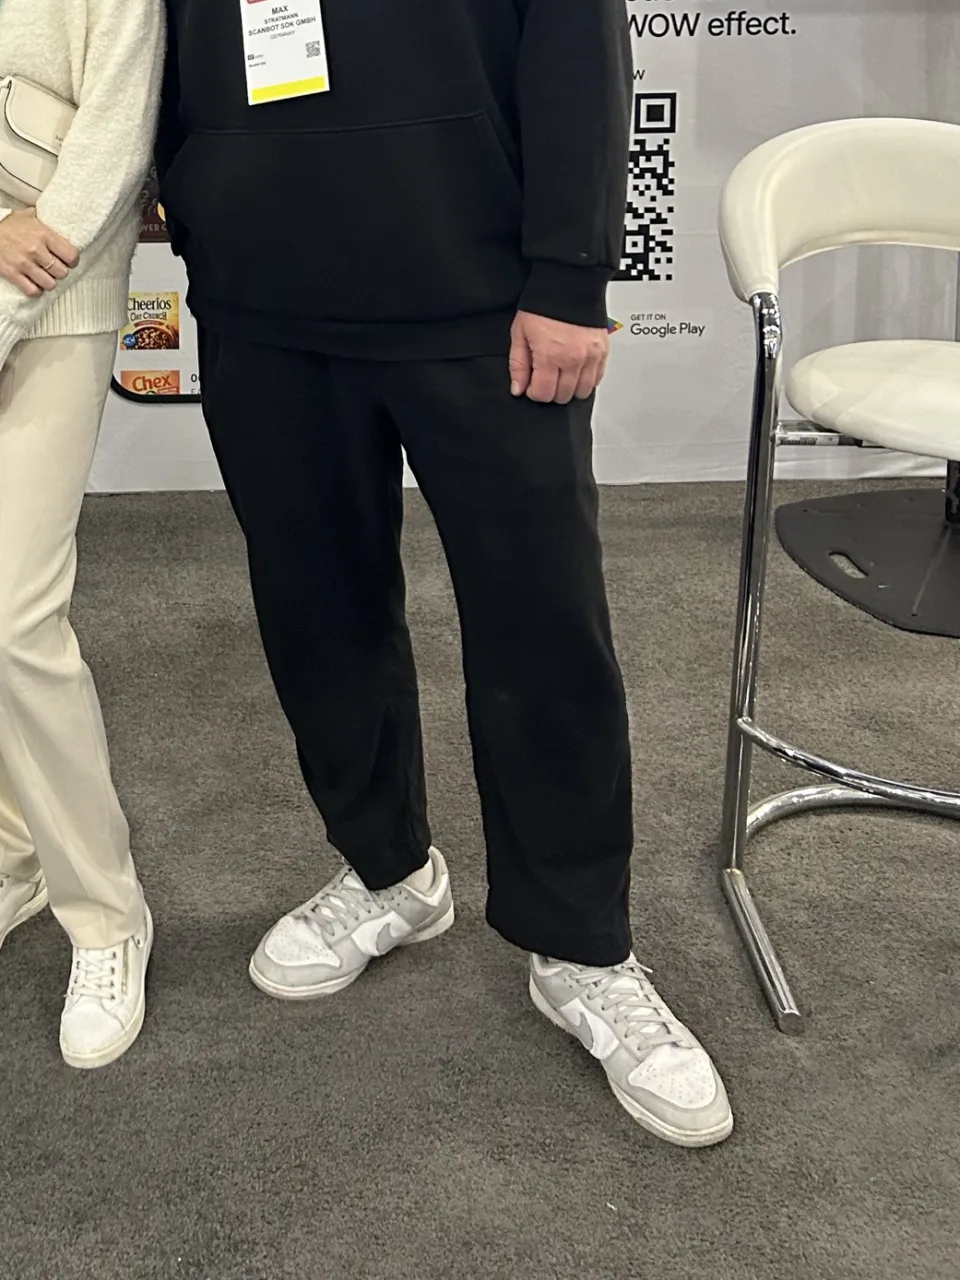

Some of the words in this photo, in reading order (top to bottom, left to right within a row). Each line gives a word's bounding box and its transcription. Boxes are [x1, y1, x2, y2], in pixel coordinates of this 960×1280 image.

[271, 5, 288, 15] MAX
[248, 24, 279, 37] SCANBOT
[628, 12, 701, 38] WOW
[707, 10, 797, 37] effect.
[127, 296, 172, 311] Cheerios
[630, 313, 645, 321] GET
[630, 322, 677, 338] Google
[679, 321, 706, 337] Play
[132, 375, 172, 392] Chex
